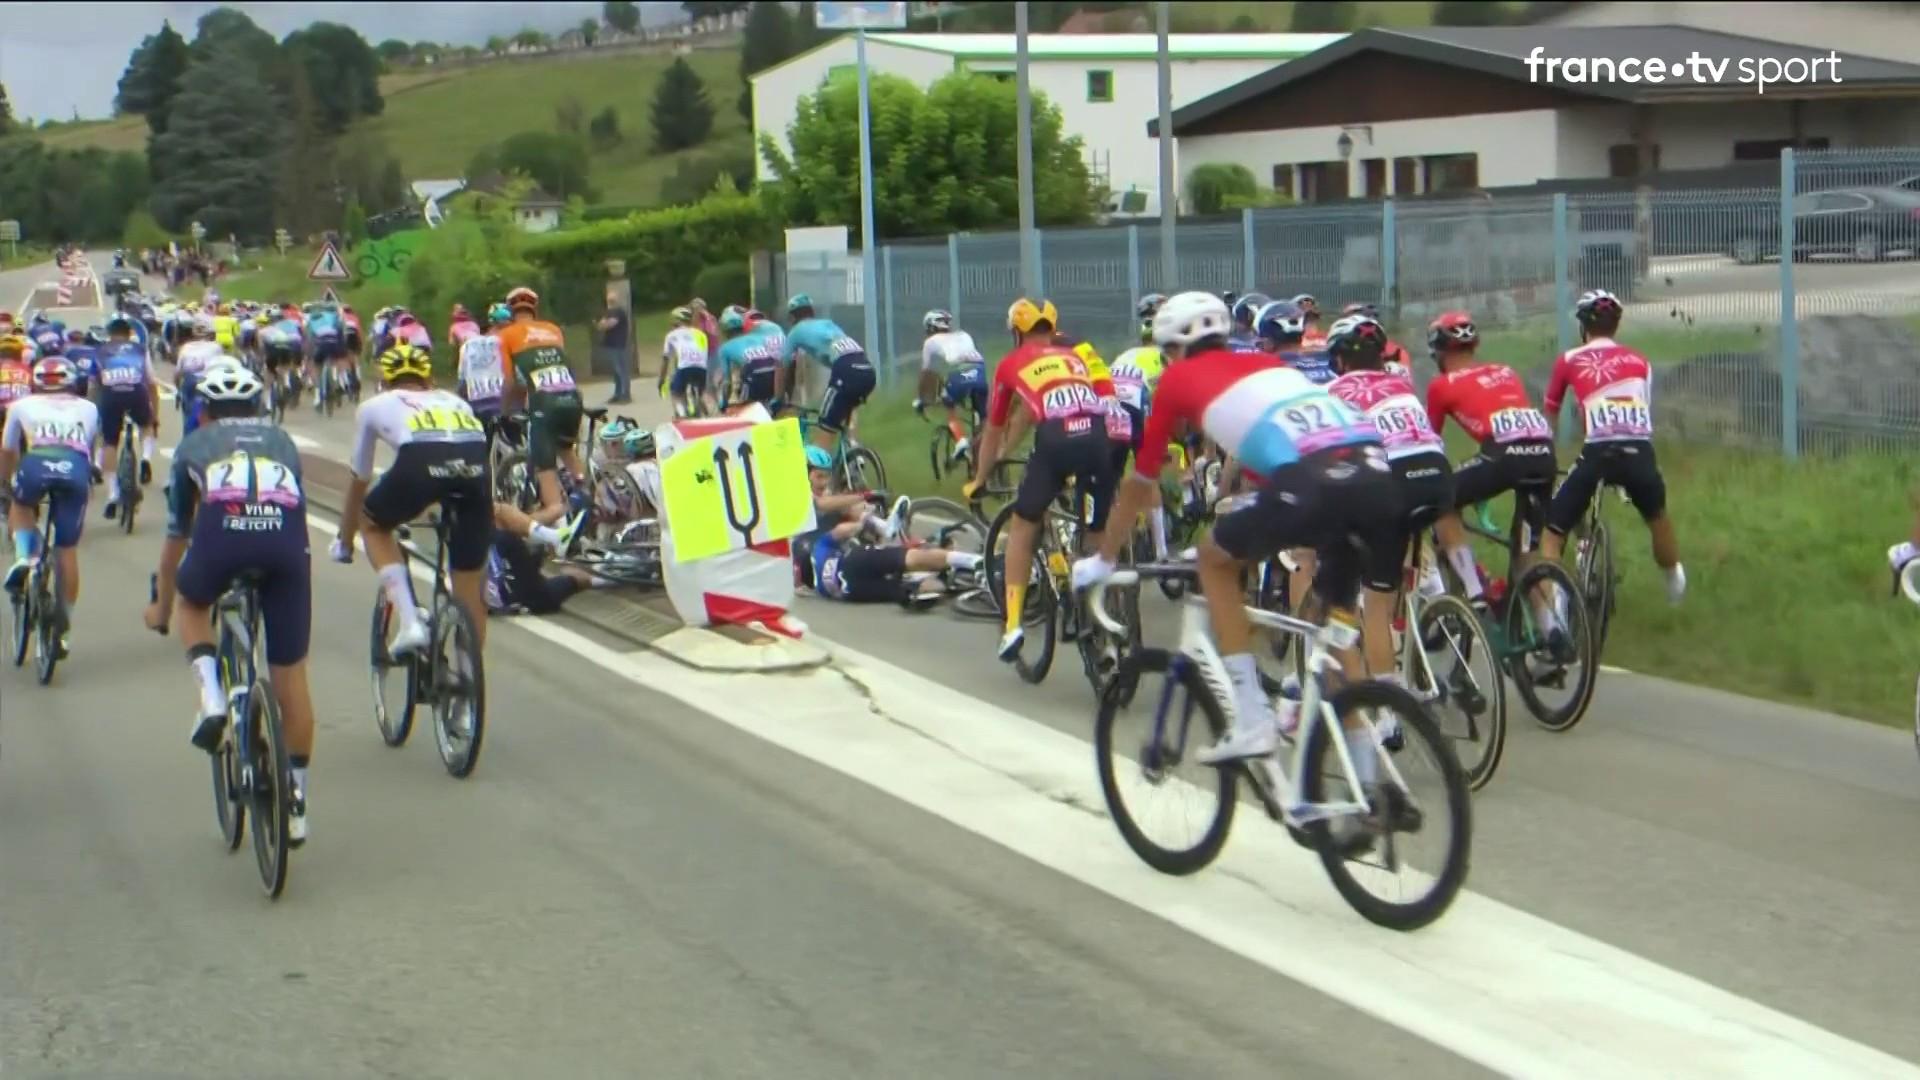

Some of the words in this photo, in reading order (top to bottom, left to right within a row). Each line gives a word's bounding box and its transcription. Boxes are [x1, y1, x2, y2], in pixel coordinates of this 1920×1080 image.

[414, 409, 437, 429] 14
[1286, 404, 1329, 433] 92
[1505, 445, 1551, 455] ARKEA
[220, 463, 233, 487] 2
[274, 464, 287, 491] 2
[245, 503, 282, 516] VISMA
